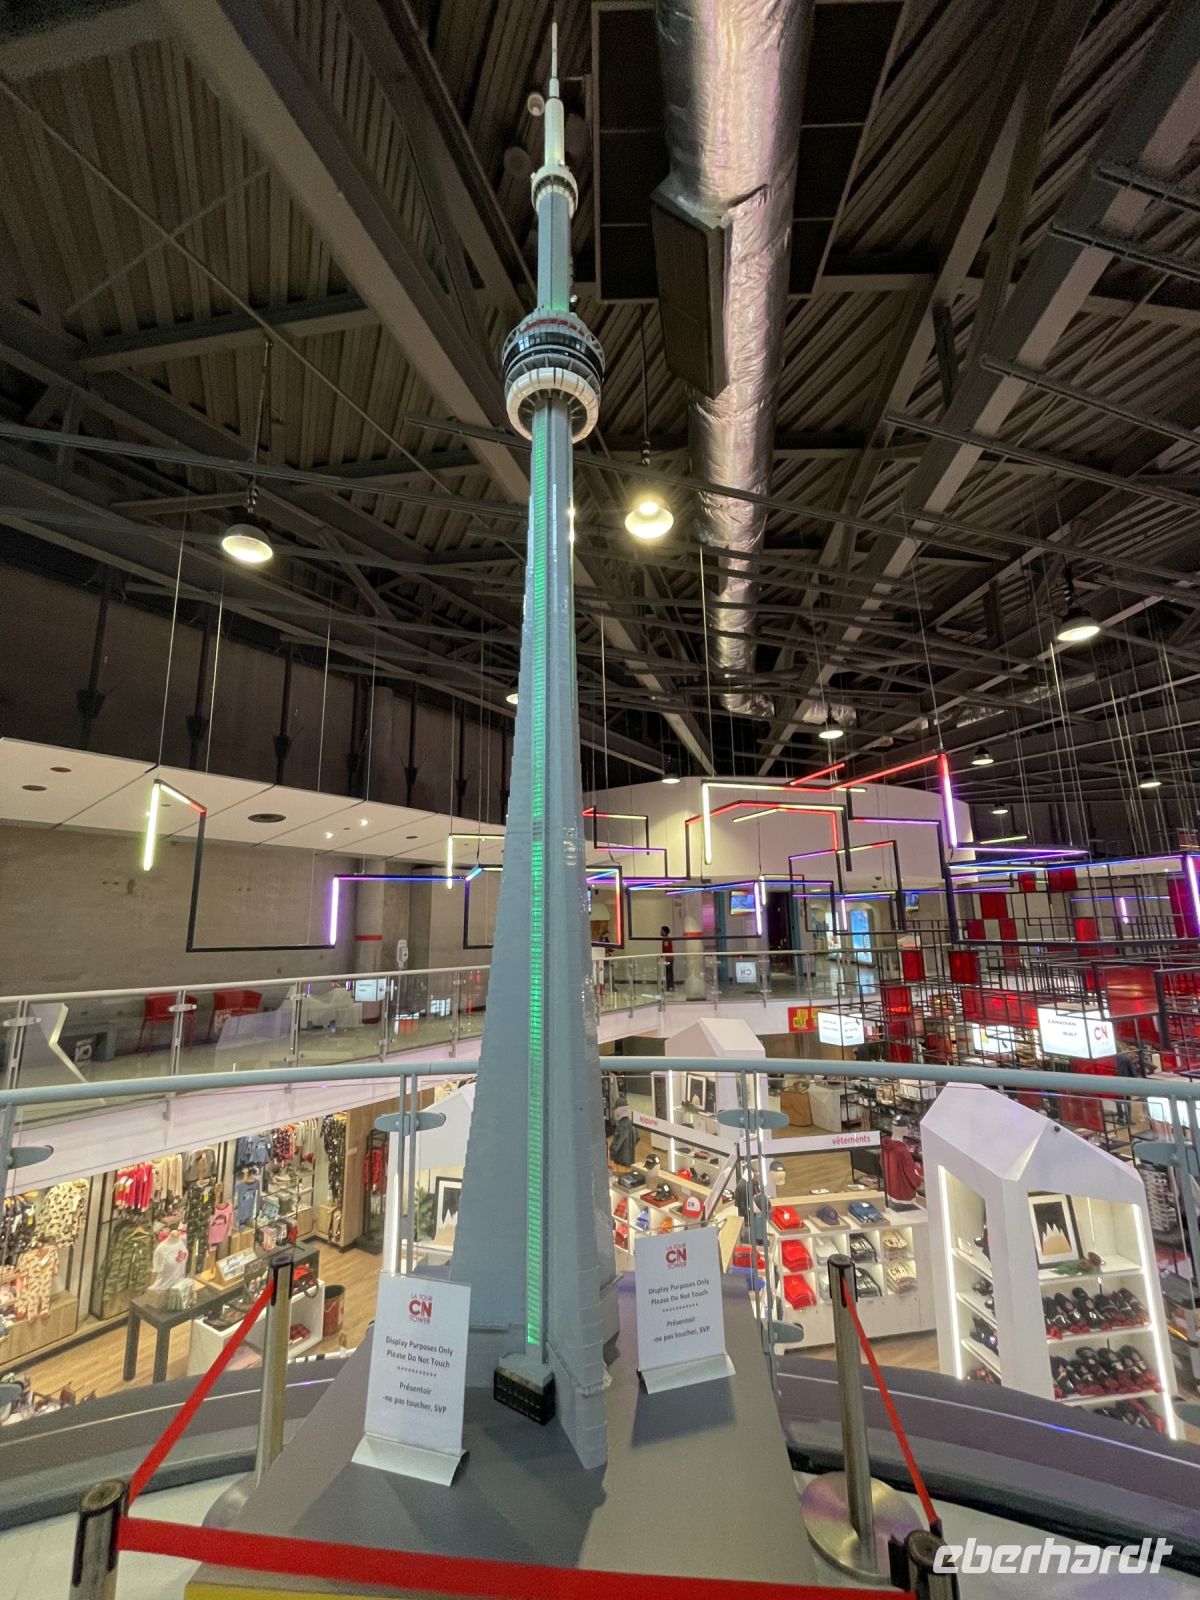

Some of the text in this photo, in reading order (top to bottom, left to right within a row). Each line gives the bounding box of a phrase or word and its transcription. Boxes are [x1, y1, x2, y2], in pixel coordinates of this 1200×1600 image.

[1094, 1026, 1108, 1040] CN
[832, 1136, 870, 1145] vêtements
[666, 1248, 687, 1263] CN
[668, 1262, 686, 1270] TOWER
[649, 1278, 709, 1295] Display Purposes Only
[692, 1290, 708, 1298] Touch
[409, 1300, 432, 1317] CN
[410, 1316, 430, 1324] TOWER
[667, 1317, 695, 1327] Présentoir
[675, 1330, 698, 1339] toucher,
[386, 1336, 453, 1356] Display Purposes Only
[387, 1350, 406, 1360] Please
[418, 1356, 429, 1364] Not
[431, 1358, 450, 1368] Touch
[400, 1382, 432, 1395] Présentoir
[394, 1398, 405, 1406] pas
[407, 1400, 432, 1412] toucher,
[435, 1405, 447, 1413] SVP
